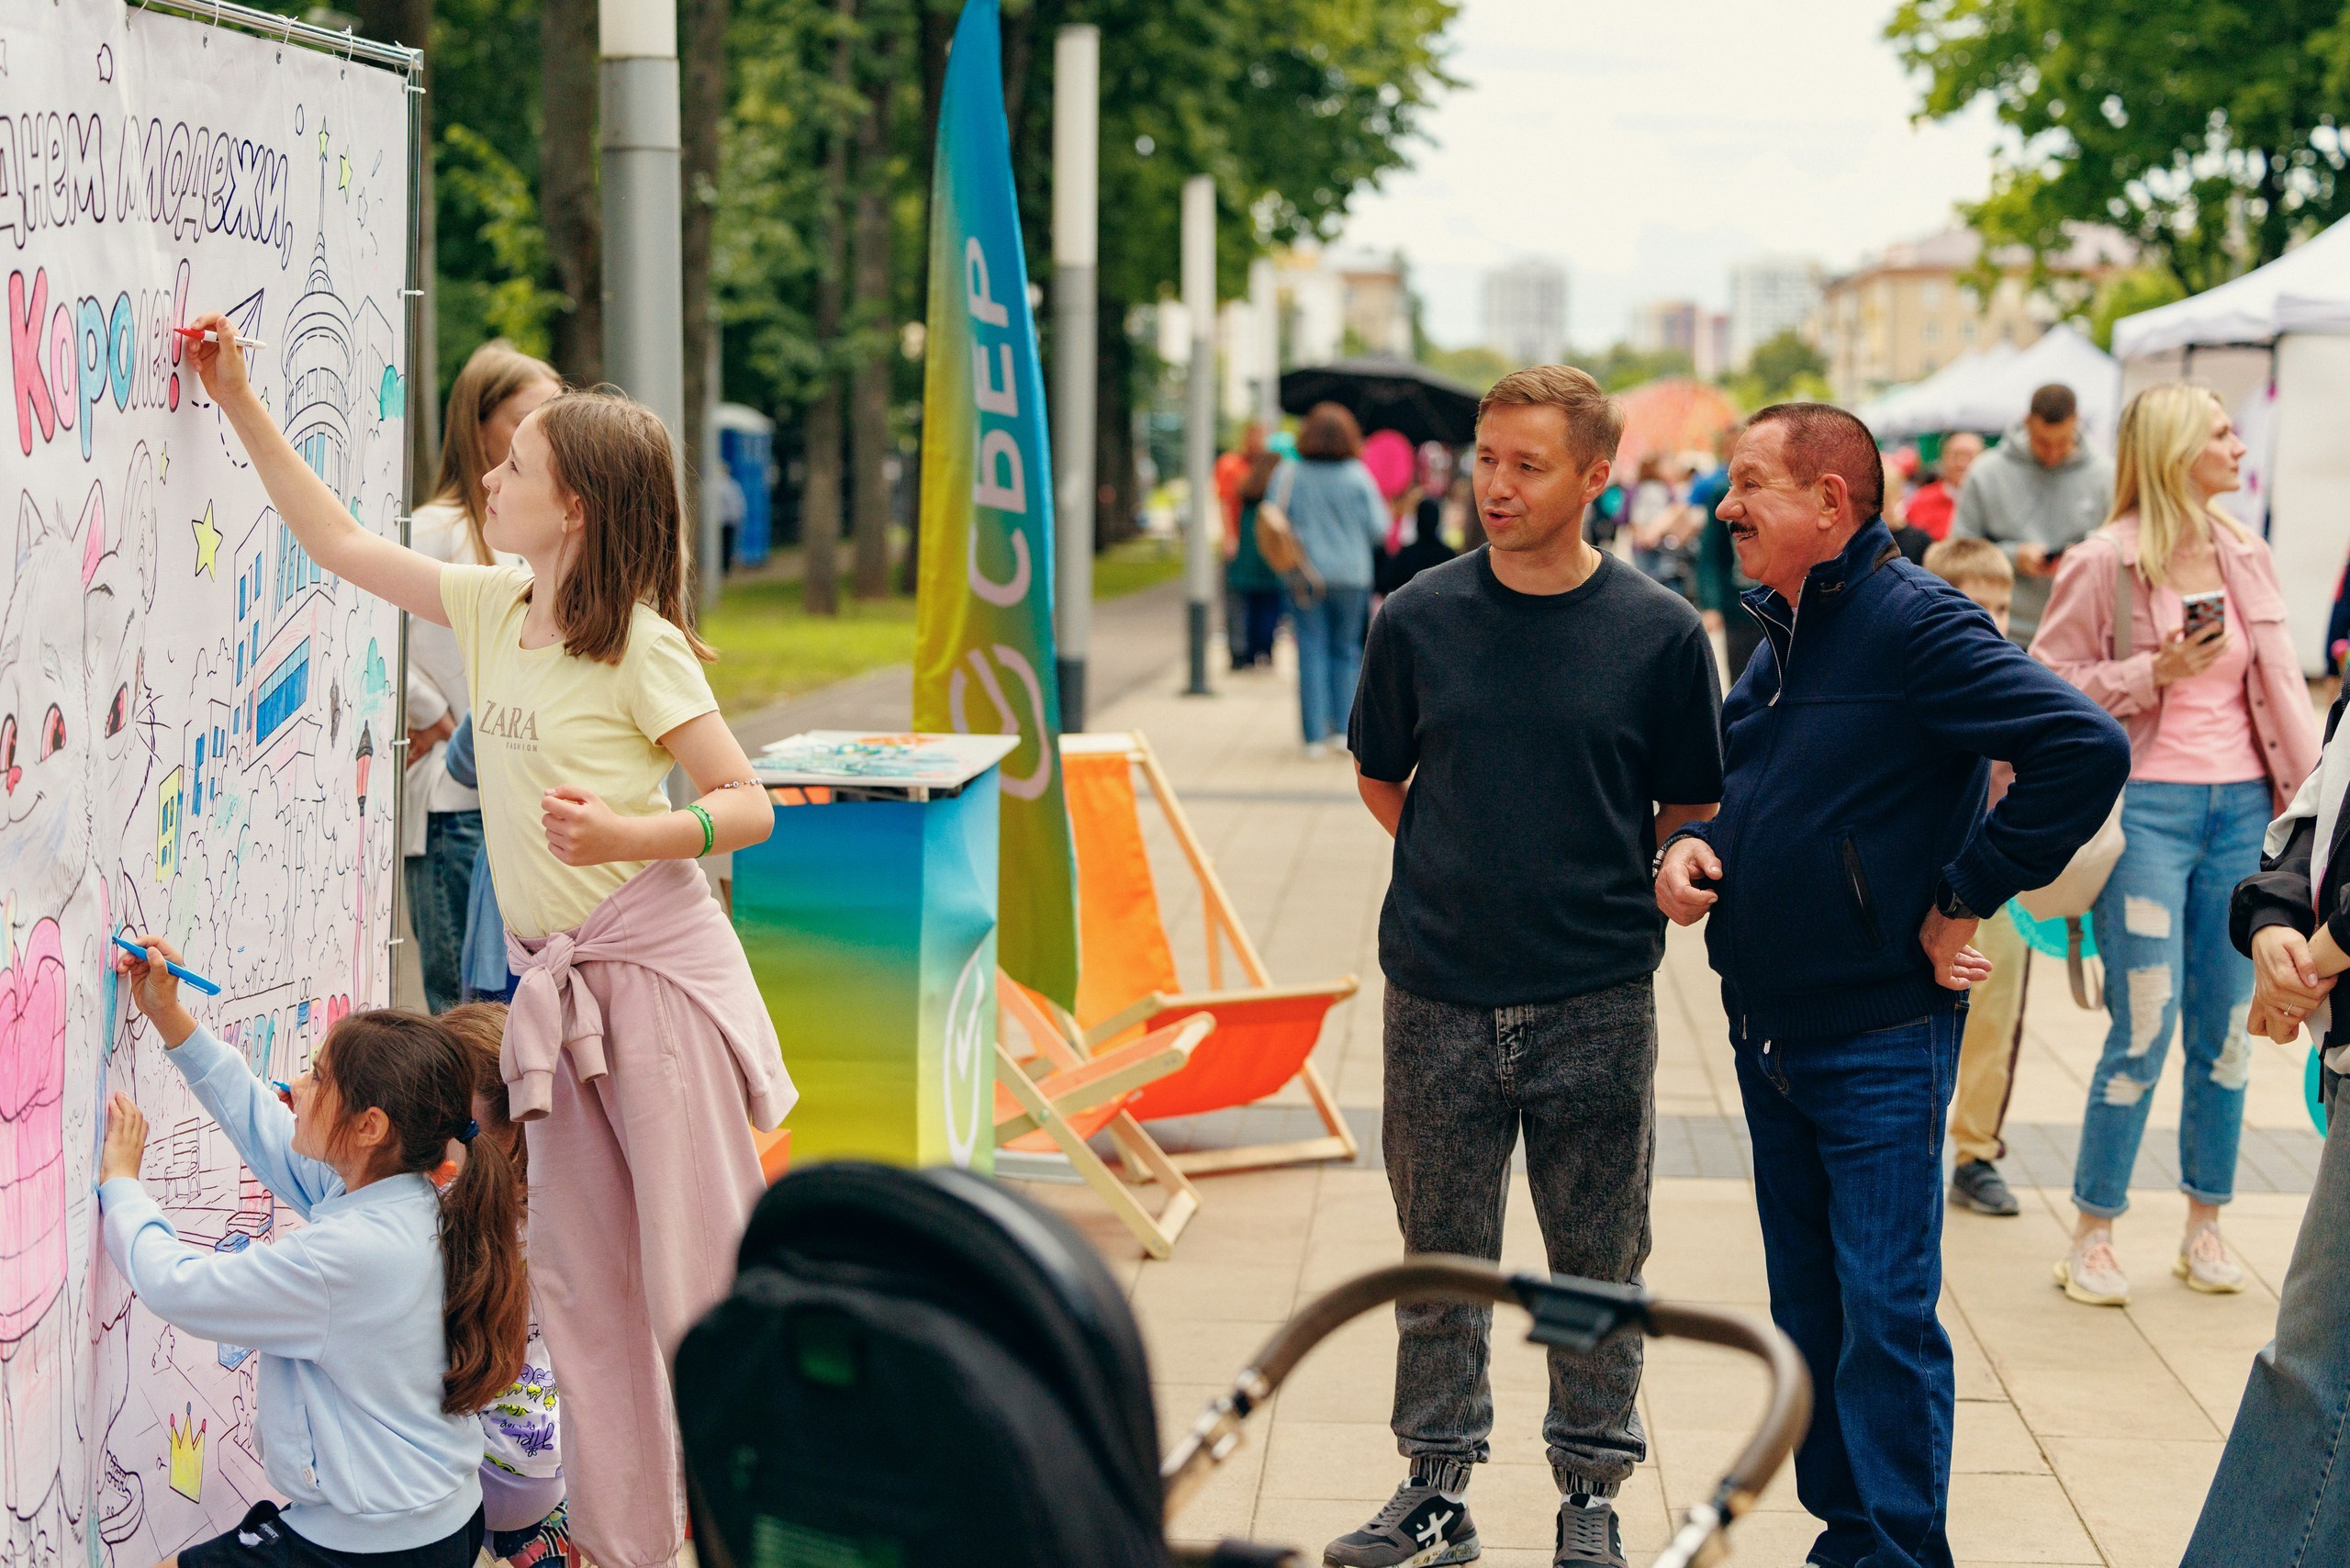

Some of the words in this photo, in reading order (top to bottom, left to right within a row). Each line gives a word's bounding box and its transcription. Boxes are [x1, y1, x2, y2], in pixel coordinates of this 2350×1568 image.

[8, 257, 191, 463] Королев!
[966, 236, 1032, 608] СБЕР
[478, 700, 540, 741] ZARA
[506, 742, 538, 752] FASHION
